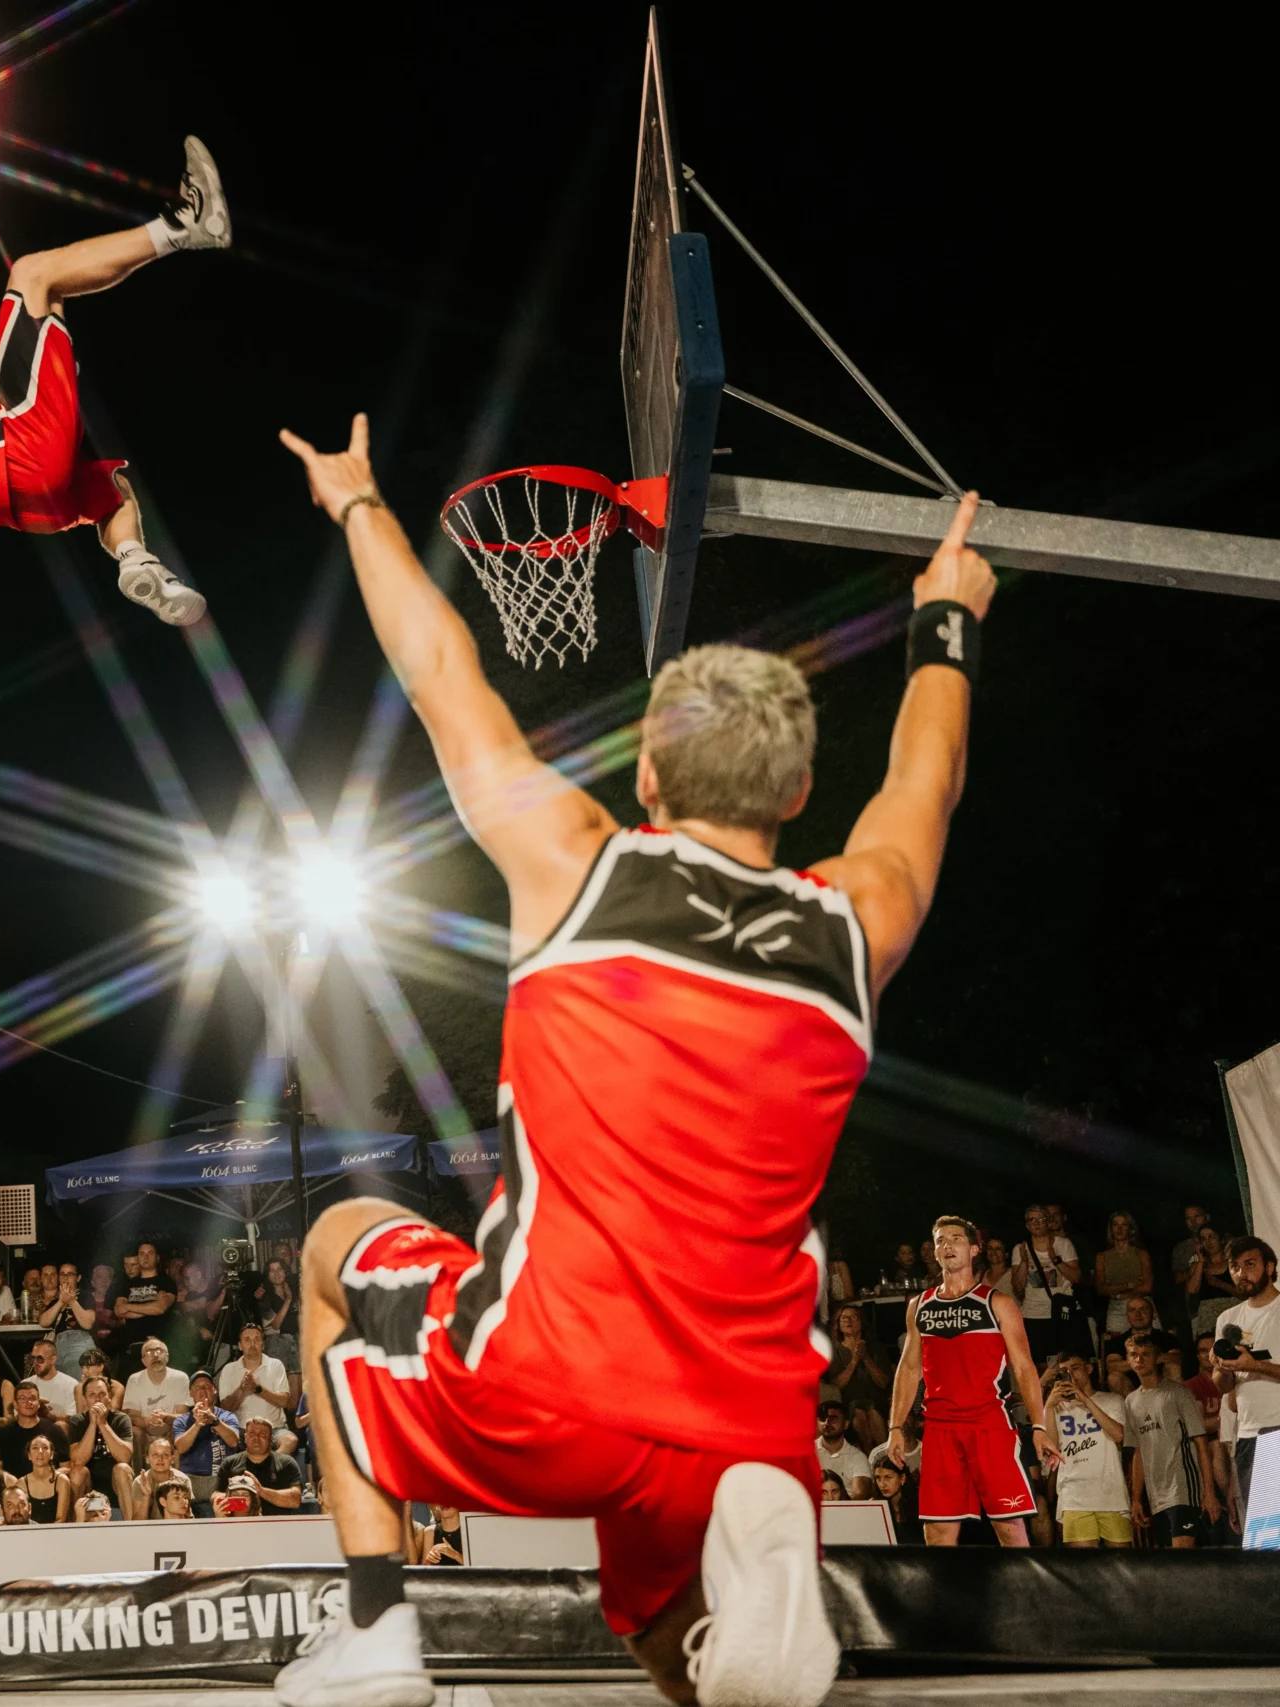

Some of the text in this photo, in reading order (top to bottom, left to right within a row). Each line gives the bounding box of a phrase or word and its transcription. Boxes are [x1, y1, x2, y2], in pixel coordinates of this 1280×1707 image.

[480, 1151, 503, 1161] BLAN
[201, 1164, 258, 1178] 1664 BLANC
[66, 1175, 120, 1189] 1664 BLANC
[920, 1306, 982, 1322] Dunking
[925, 1316, 969, 1331] Devils
[1059, 1412, 1102, 1436] 3x3
